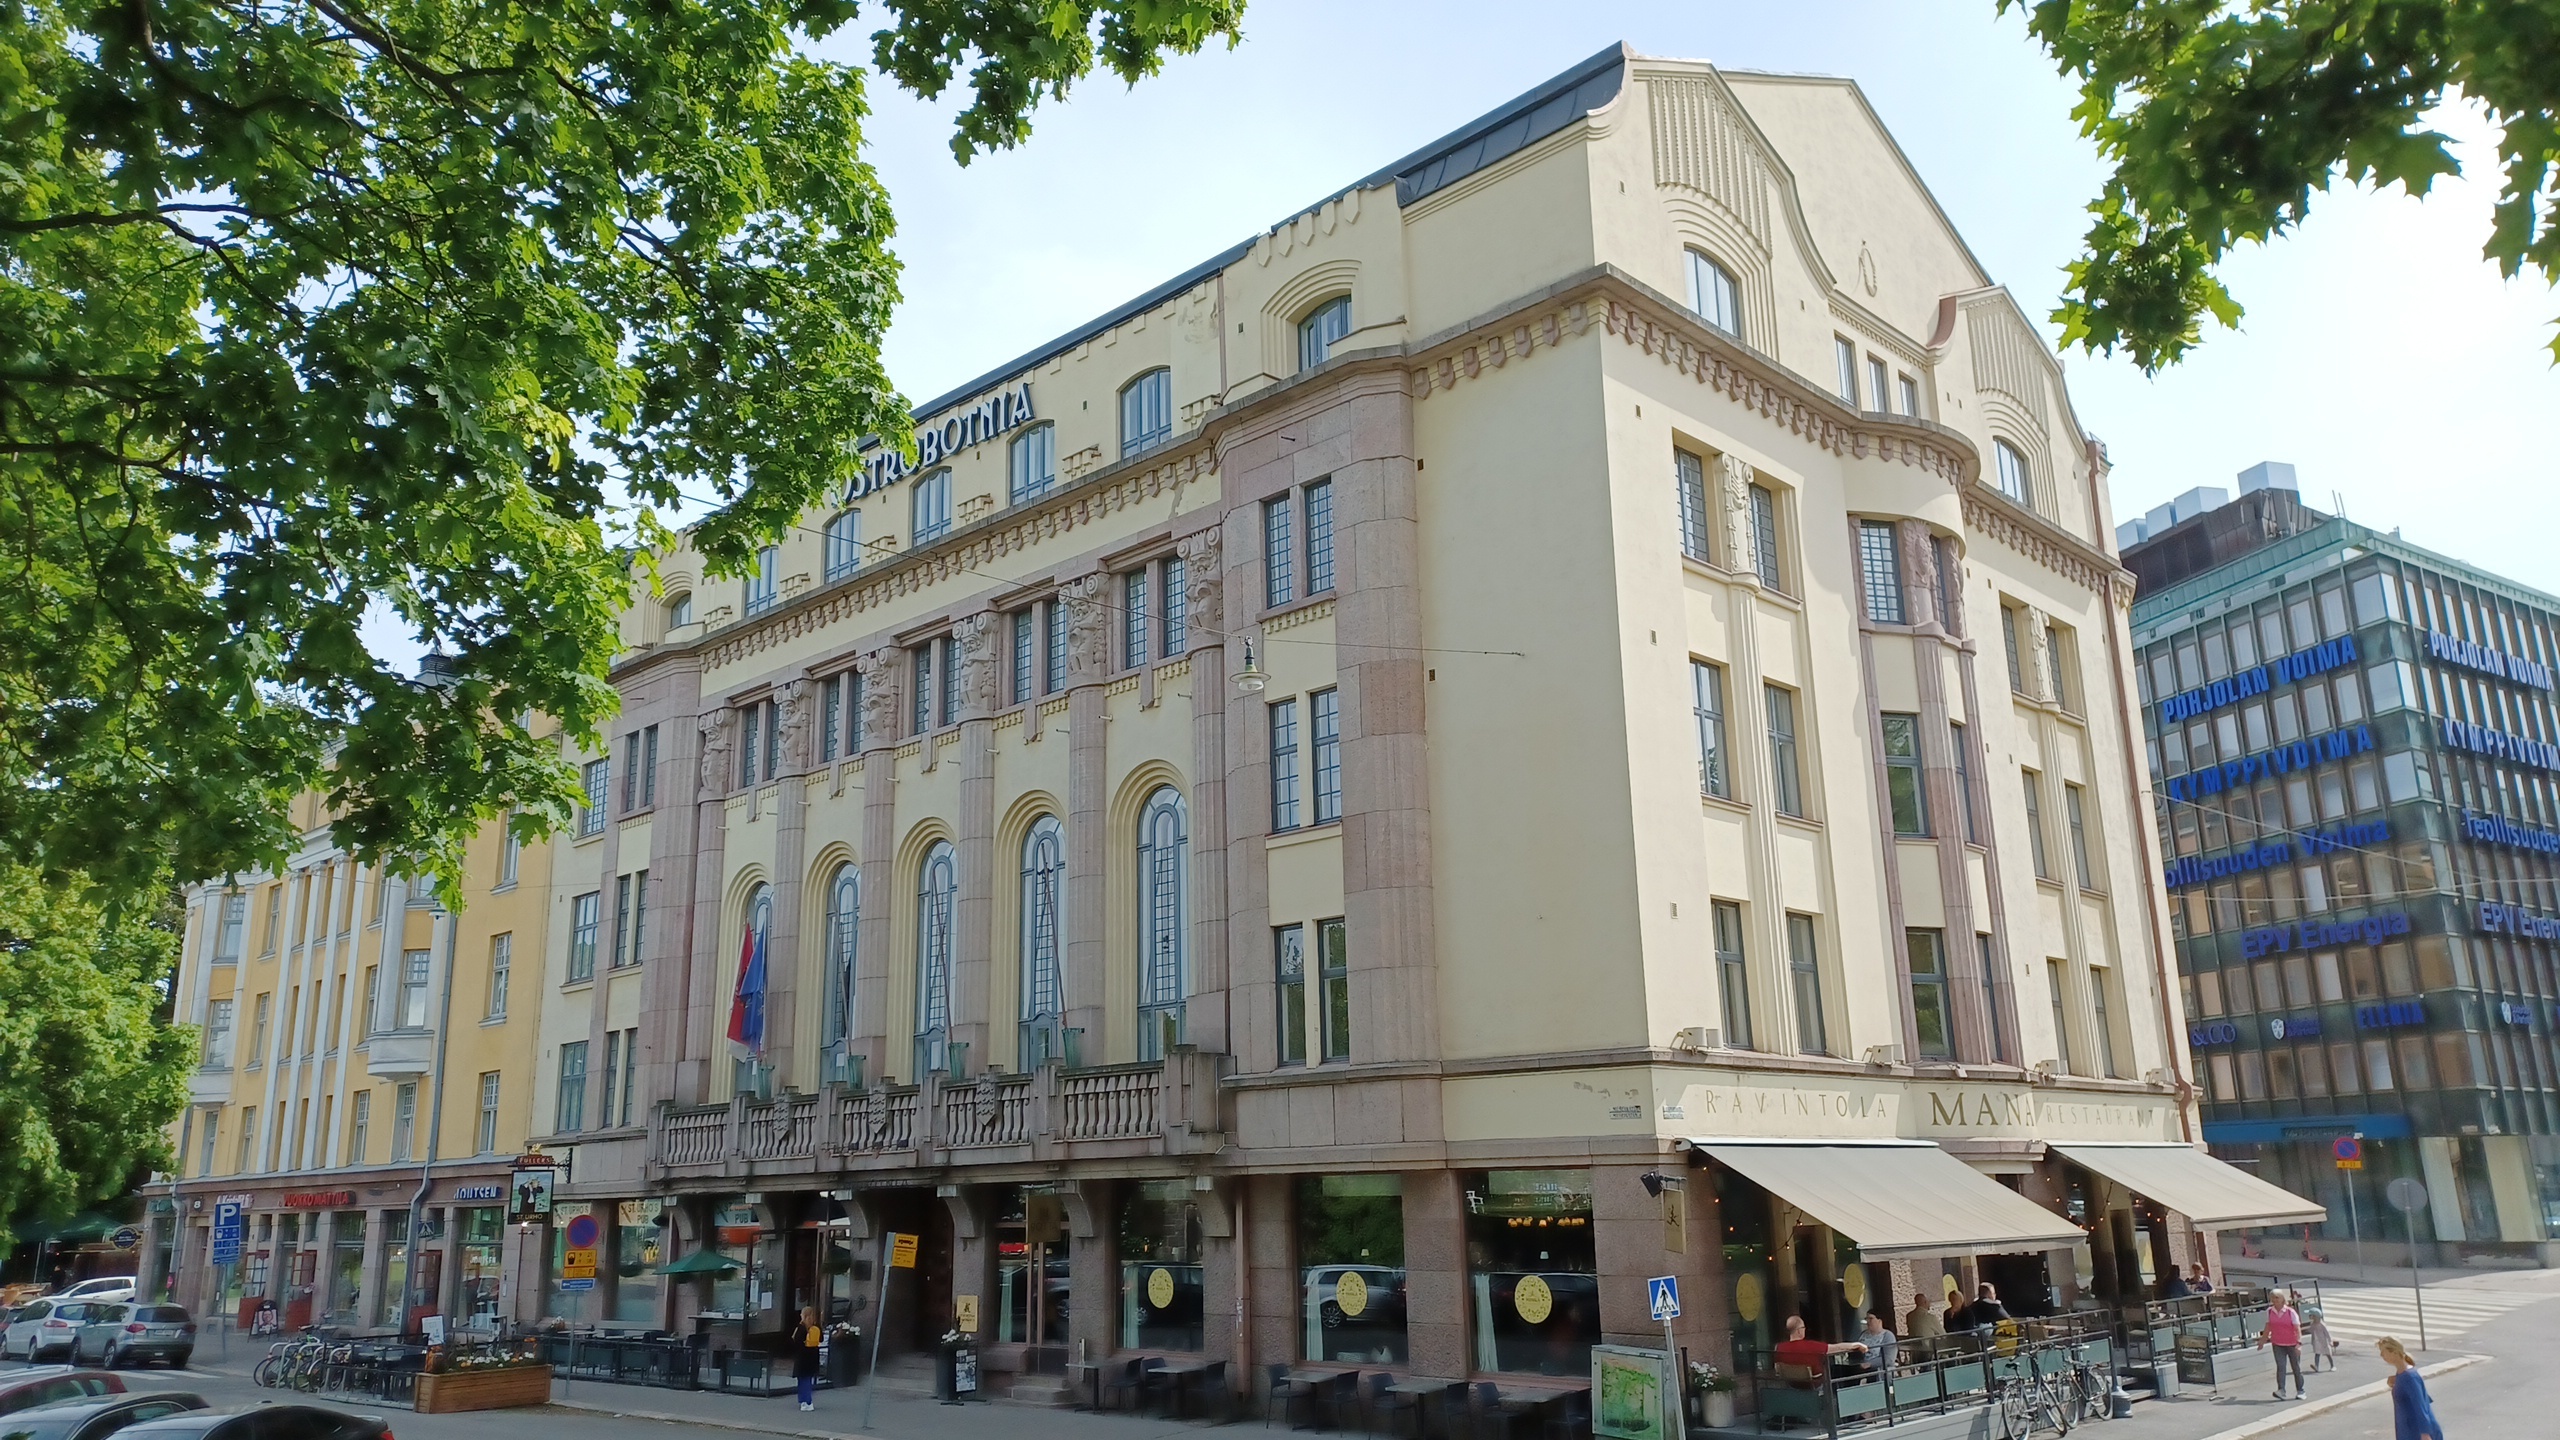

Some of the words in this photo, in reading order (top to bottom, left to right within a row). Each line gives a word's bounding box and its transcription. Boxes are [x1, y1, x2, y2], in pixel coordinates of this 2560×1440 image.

[2429, 630, 2506, 677] POHJOLAN
[2507, 654, 2555, 691] VOIMA
[2163, 666, 2270, 724] POHJOLAN
[2276, 635, 2357, 685] VOIMA
[2170, 725, 2374, 803] KYMPPIVOIMA
[2300, 820, 2391, 857] Voima
[2480, 902, 2516, 934] EPV
[2241, 925, 2291, 959] EPV
[2301, 912, 2411, 949] Energia
[2357, 1002, 2426, 1028] ELENIA
[1706, 1089, 1887, 1118] RAVINTOLA
[2046, 1104, 2157, 1129] RESTAURANT
[194, 1200, 200, 1209] 8
[220, 1204, 237, 1226] P
[734, 1213, 748, 1224] PUB
[637, 1215, 649, 1224] PUB
